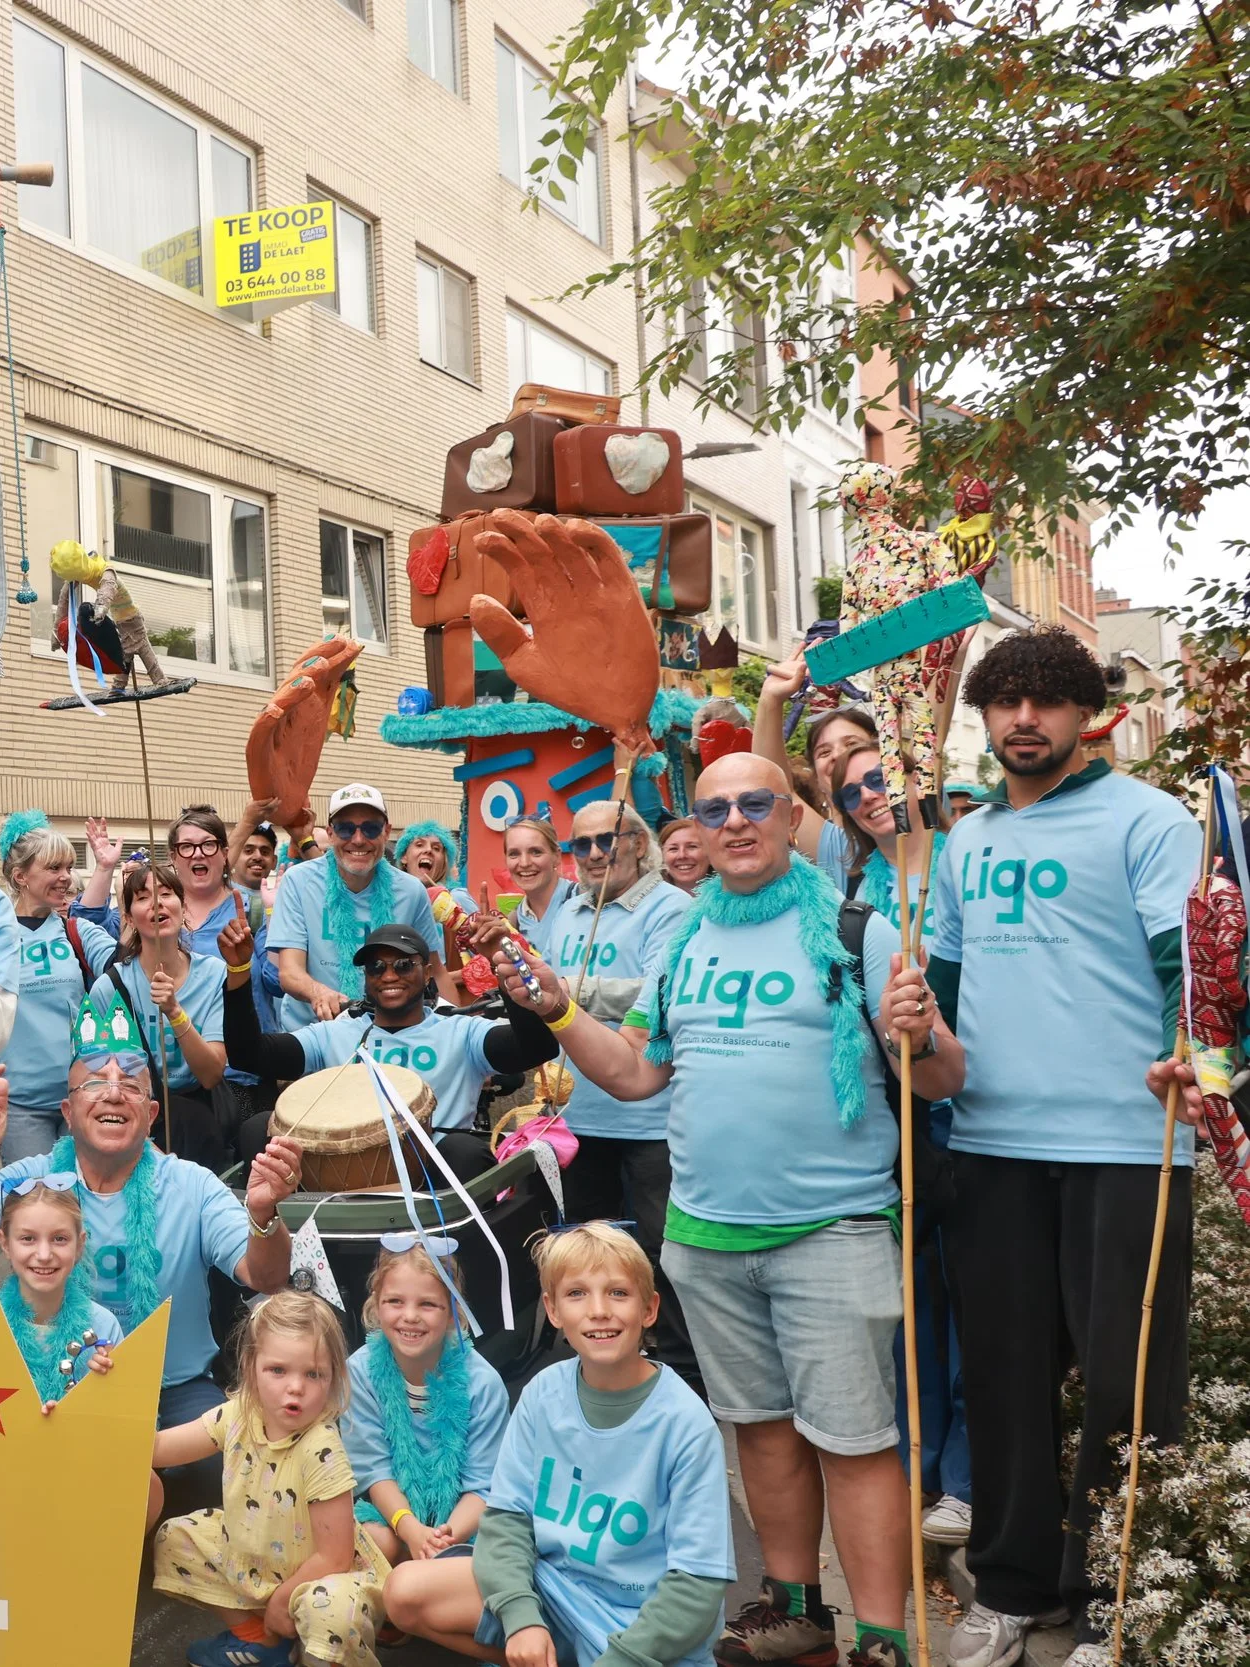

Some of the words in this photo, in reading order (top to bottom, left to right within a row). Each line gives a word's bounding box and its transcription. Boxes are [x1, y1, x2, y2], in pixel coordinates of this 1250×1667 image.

[223, 217, 252, 237] TE
[258, 207, 324, 232] KOOP
[263, 241, 288, 250] IMMO
[264, 249, 277, 260] DE
[280, 246, 306, 257] LAET
[225, 279, 243, 293] 03
[247, 274, 276, 289] 644
[280, 271, 301, 284] 00
[305, 268, 326, 281] 88
[226, 283, 326, 303] www.immodelaet.be
[961, 846, 1069, 925] Ligo
[1004, 933, 1070, 945] Basiseducatie
[20, 938, 70, 976] igo
[560, 934, 618, 978] Ligo
[675, 956, 796, 1029] Ligo
[701, 1036, 721, 1045] voor
[722, 1036, 791, 1049] Basiseducatie
[533, 1456, 649, 1567] Ligo
